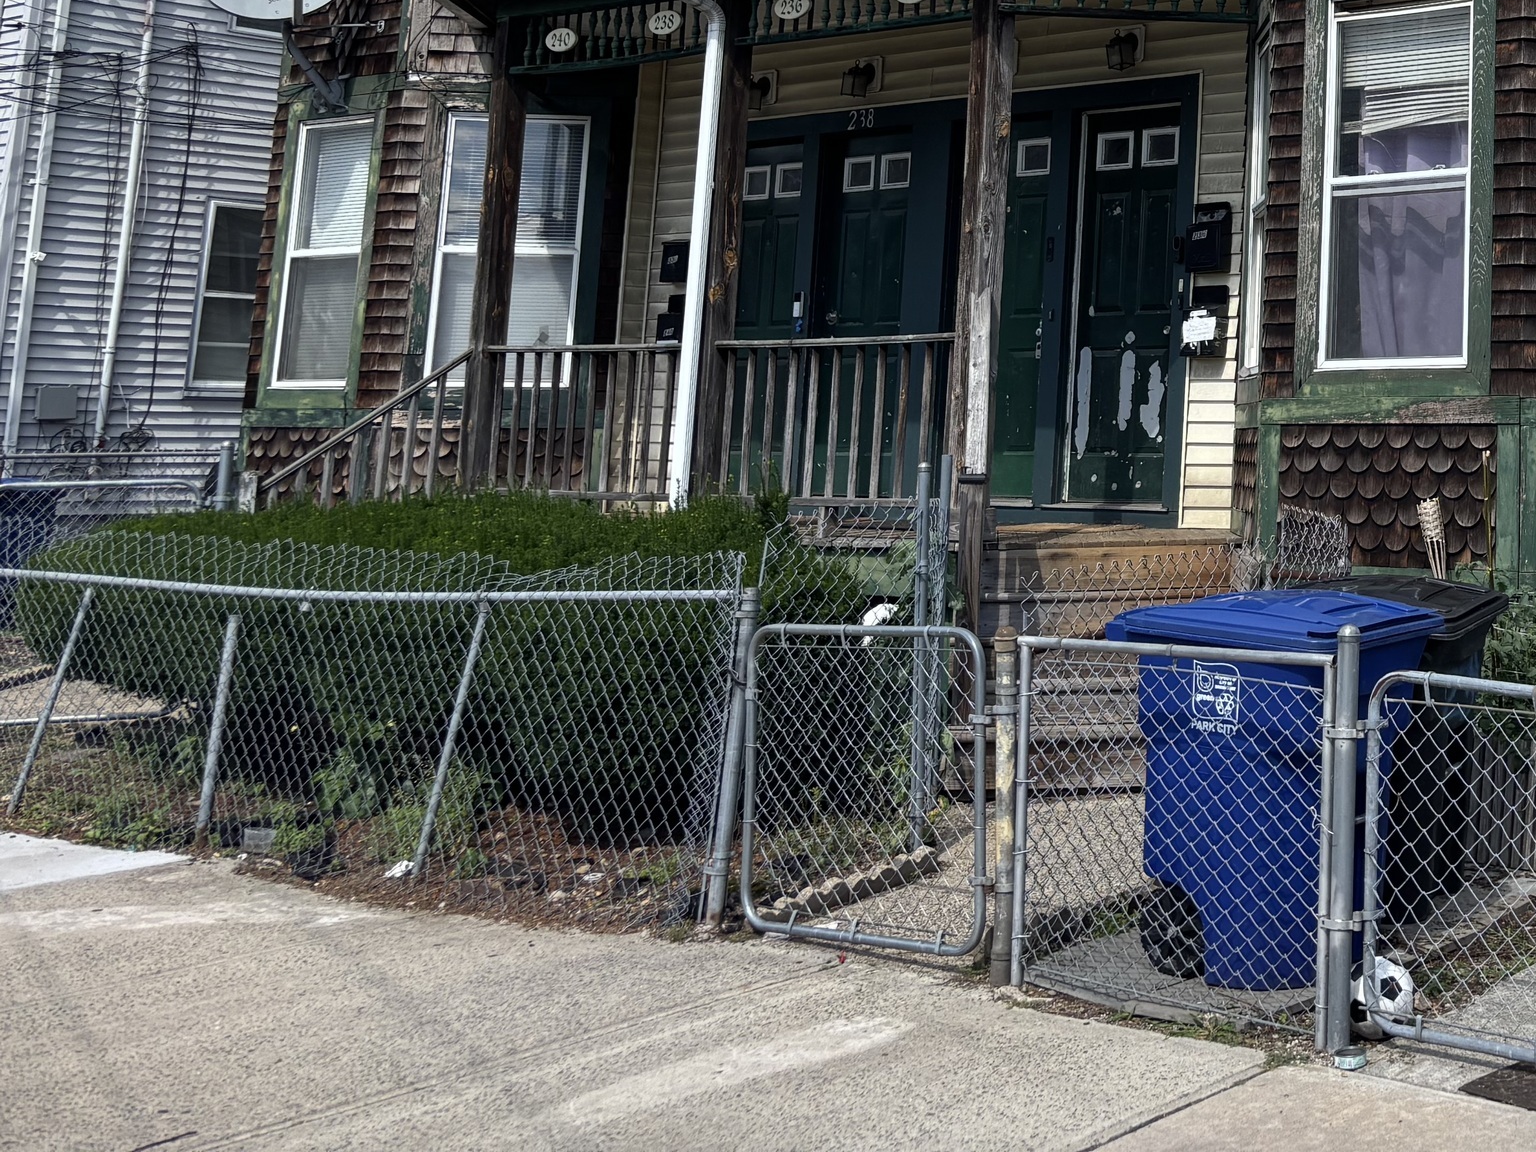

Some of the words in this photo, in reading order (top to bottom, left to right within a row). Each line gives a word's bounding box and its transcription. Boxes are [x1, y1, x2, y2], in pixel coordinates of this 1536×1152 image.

[654, 13, 675, 30] 238
[551, 32, 571, 48] 240
[847, 108, 875, 131] 238
